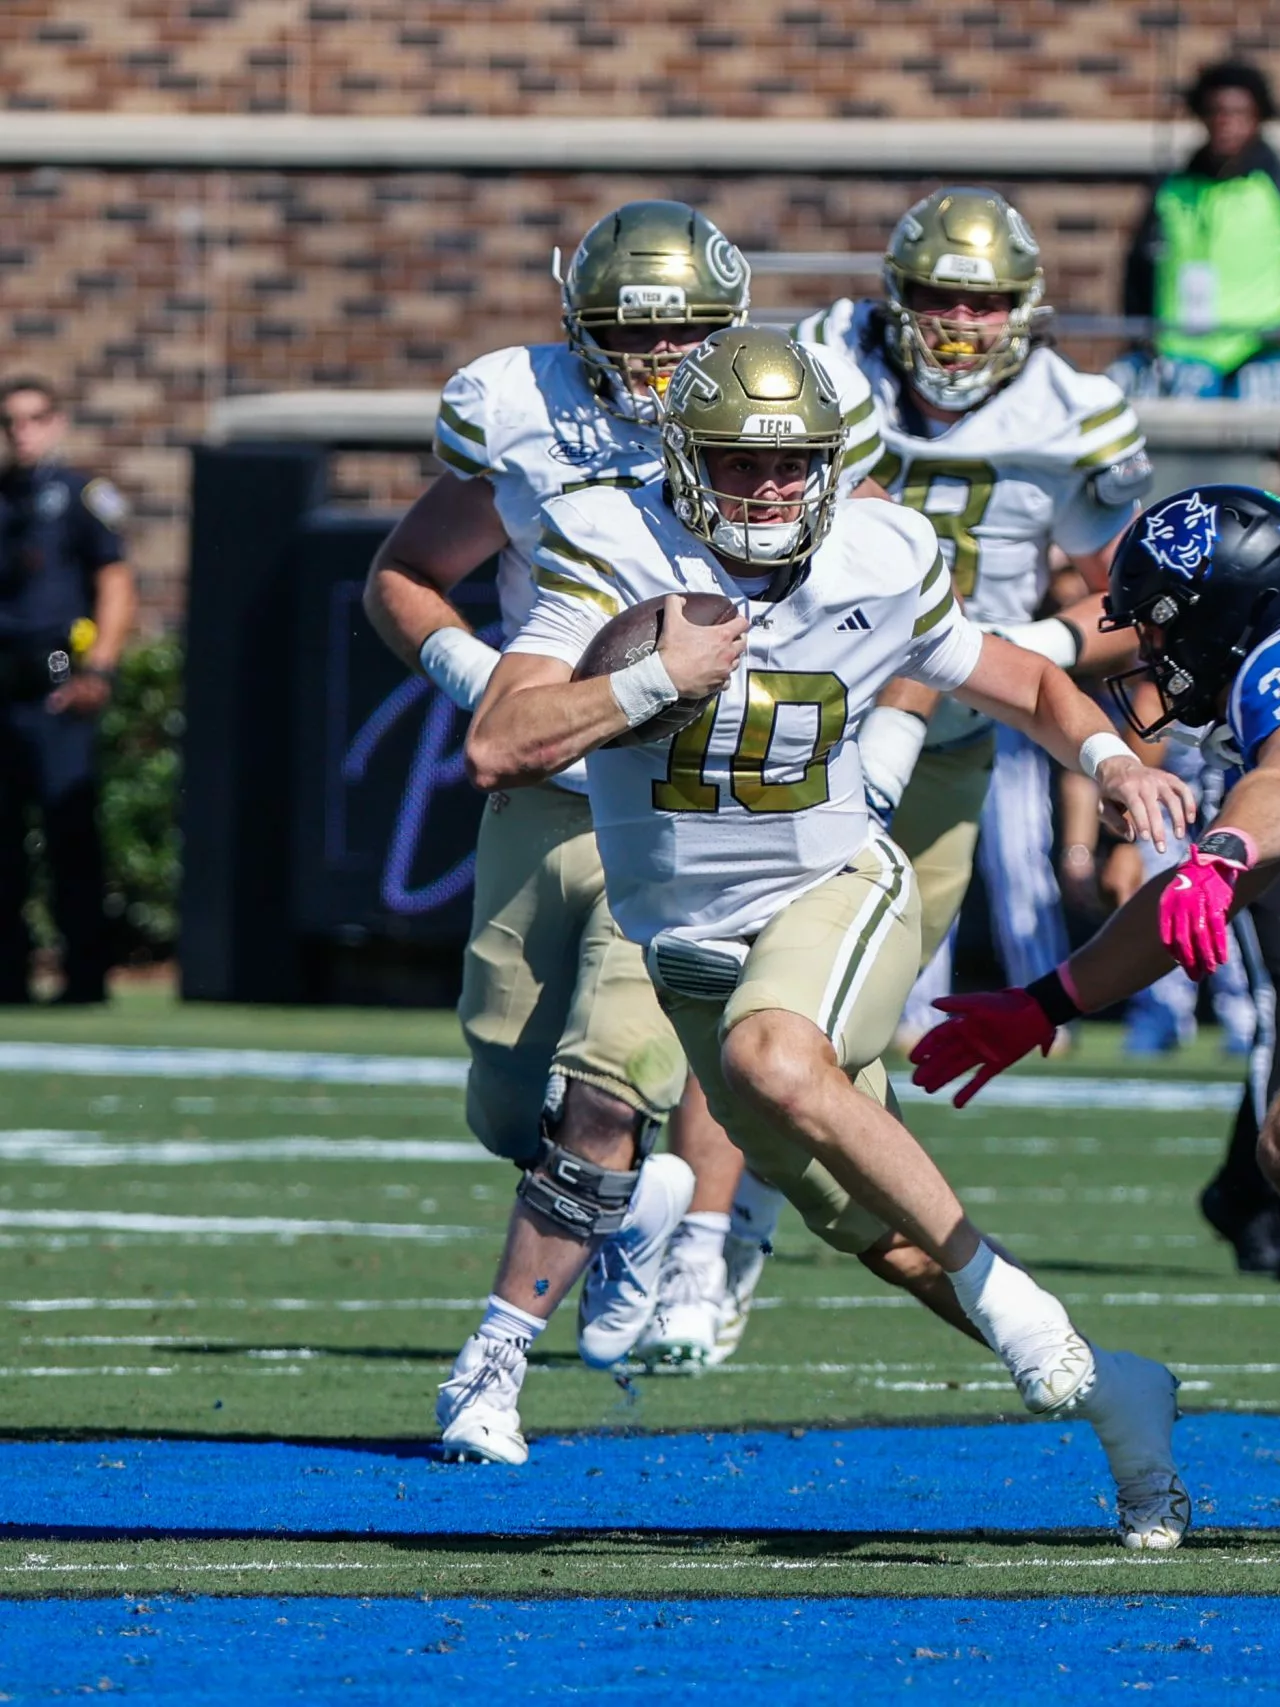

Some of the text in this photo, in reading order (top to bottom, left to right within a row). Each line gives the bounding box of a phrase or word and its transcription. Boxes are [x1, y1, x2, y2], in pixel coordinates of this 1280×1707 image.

[642, 292, 662, 302] TECH
[759, 419, 792, 434] TECH
[869, 452, 998, 598] 8
[652, 668, 849, 813] 10
